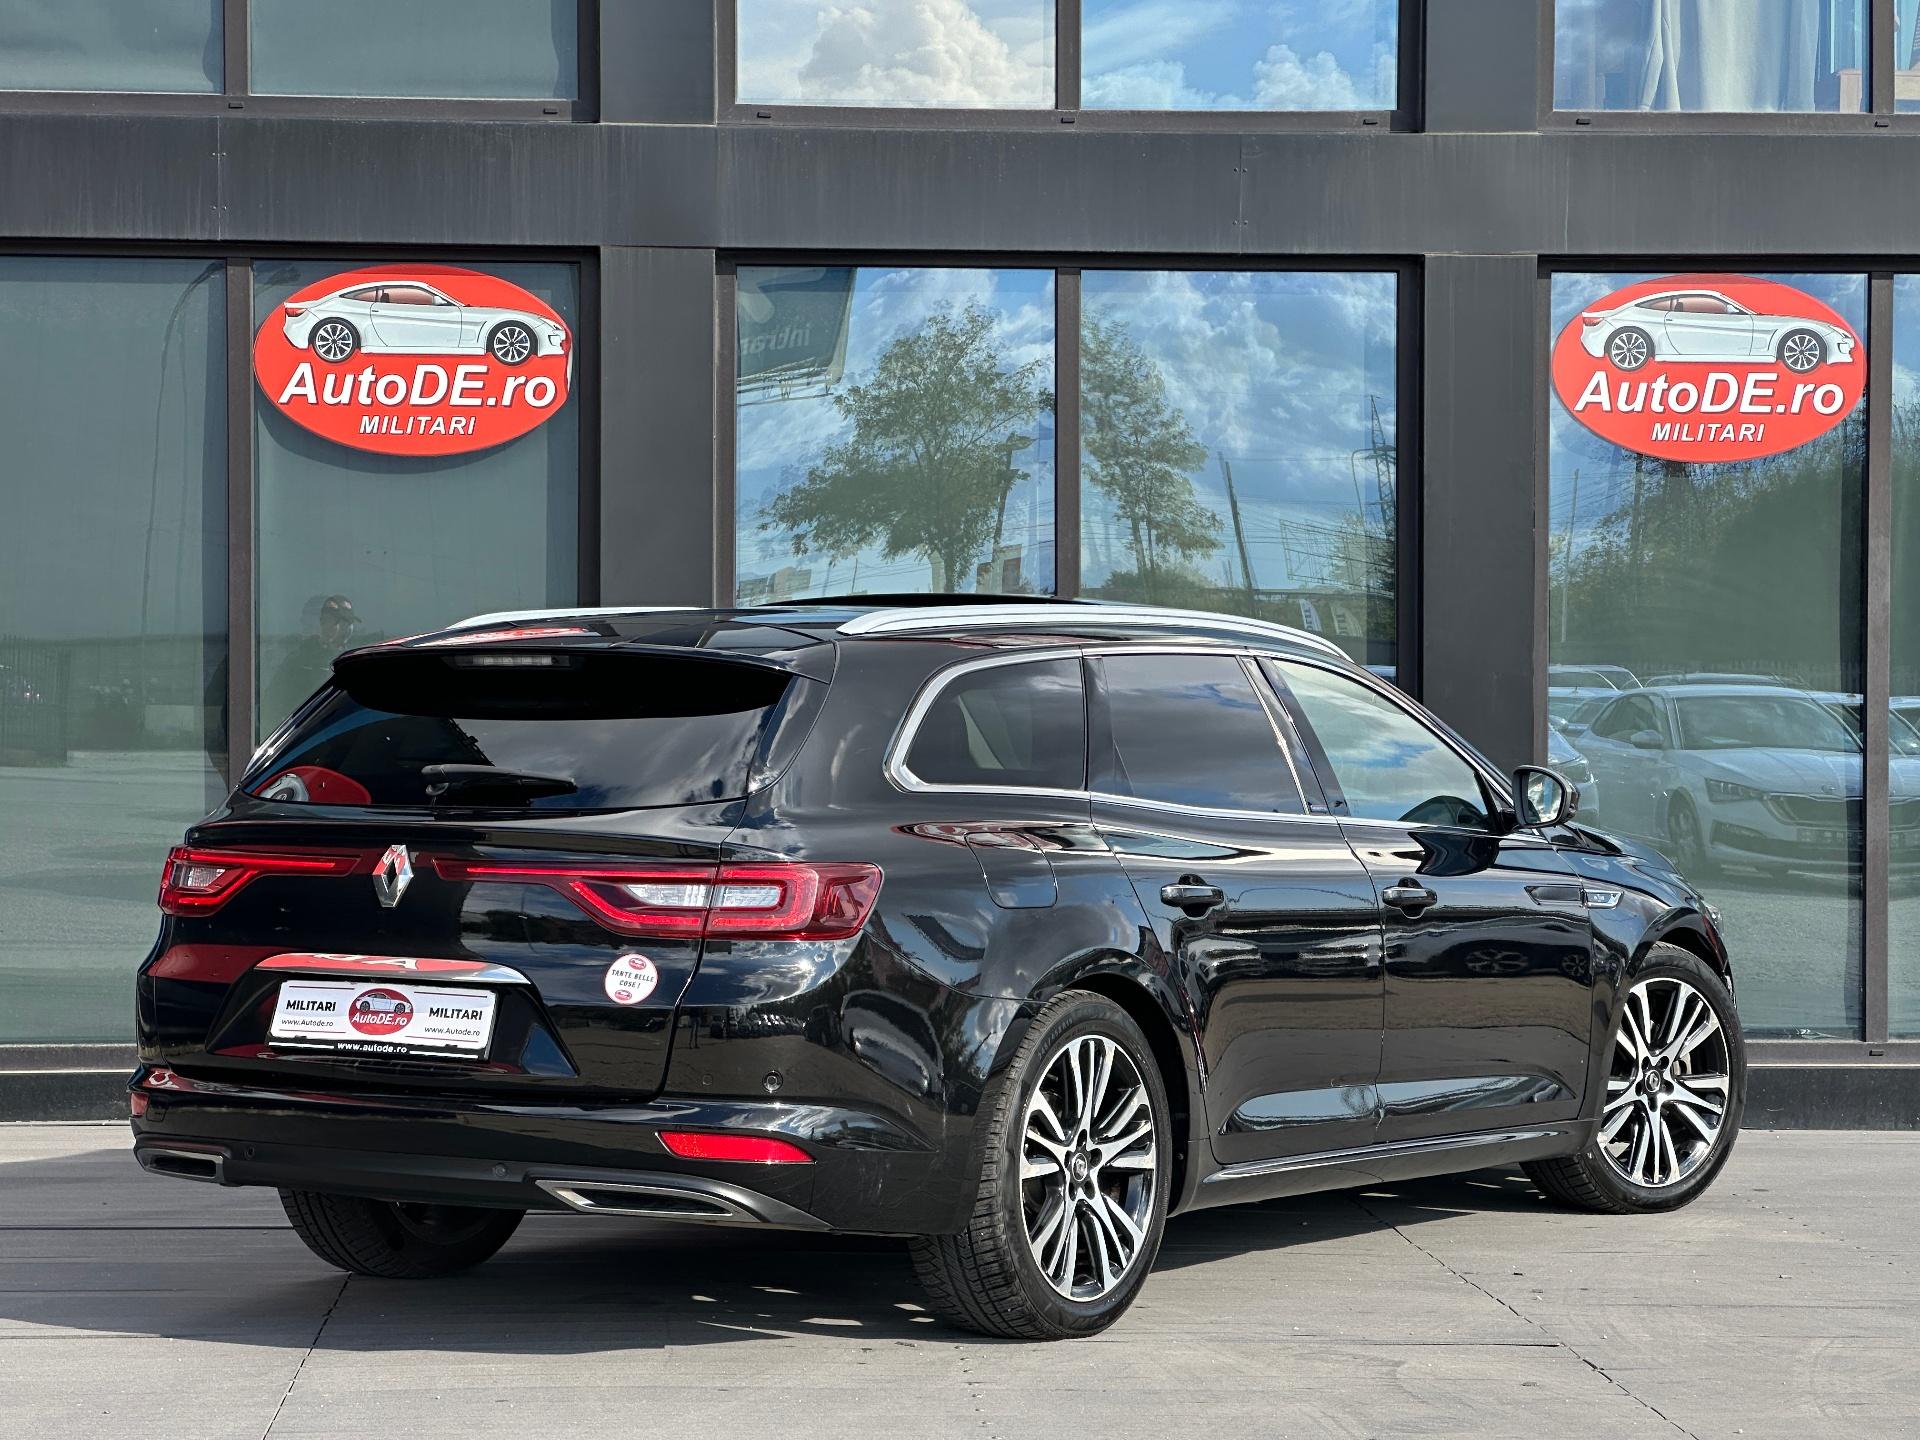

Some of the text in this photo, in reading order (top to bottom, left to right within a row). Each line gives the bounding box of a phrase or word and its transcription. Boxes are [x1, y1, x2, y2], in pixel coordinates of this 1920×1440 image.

[278, 362, 556, 407] AutoDE.ro
[1574, 371, 1845, 415] AutoDE.ro
[359, 415, 476, 435] MILITARI
[1651, 423, 1765, 442] MILITARI
[611, 969, 654, 982] TANTE BELLE
[286, 999, 336, 1012] MILITARI
[351, 1012, 408, 1026] AutoDE.ro
[428, 1007, 483, 1021] MILITARI
[281, 1018, 334, 1027] www.Autode.ro
[424, 1026, 481, 1037] www.Autode.ro
[337, 1041, 408, 1054] www.autode.ro
